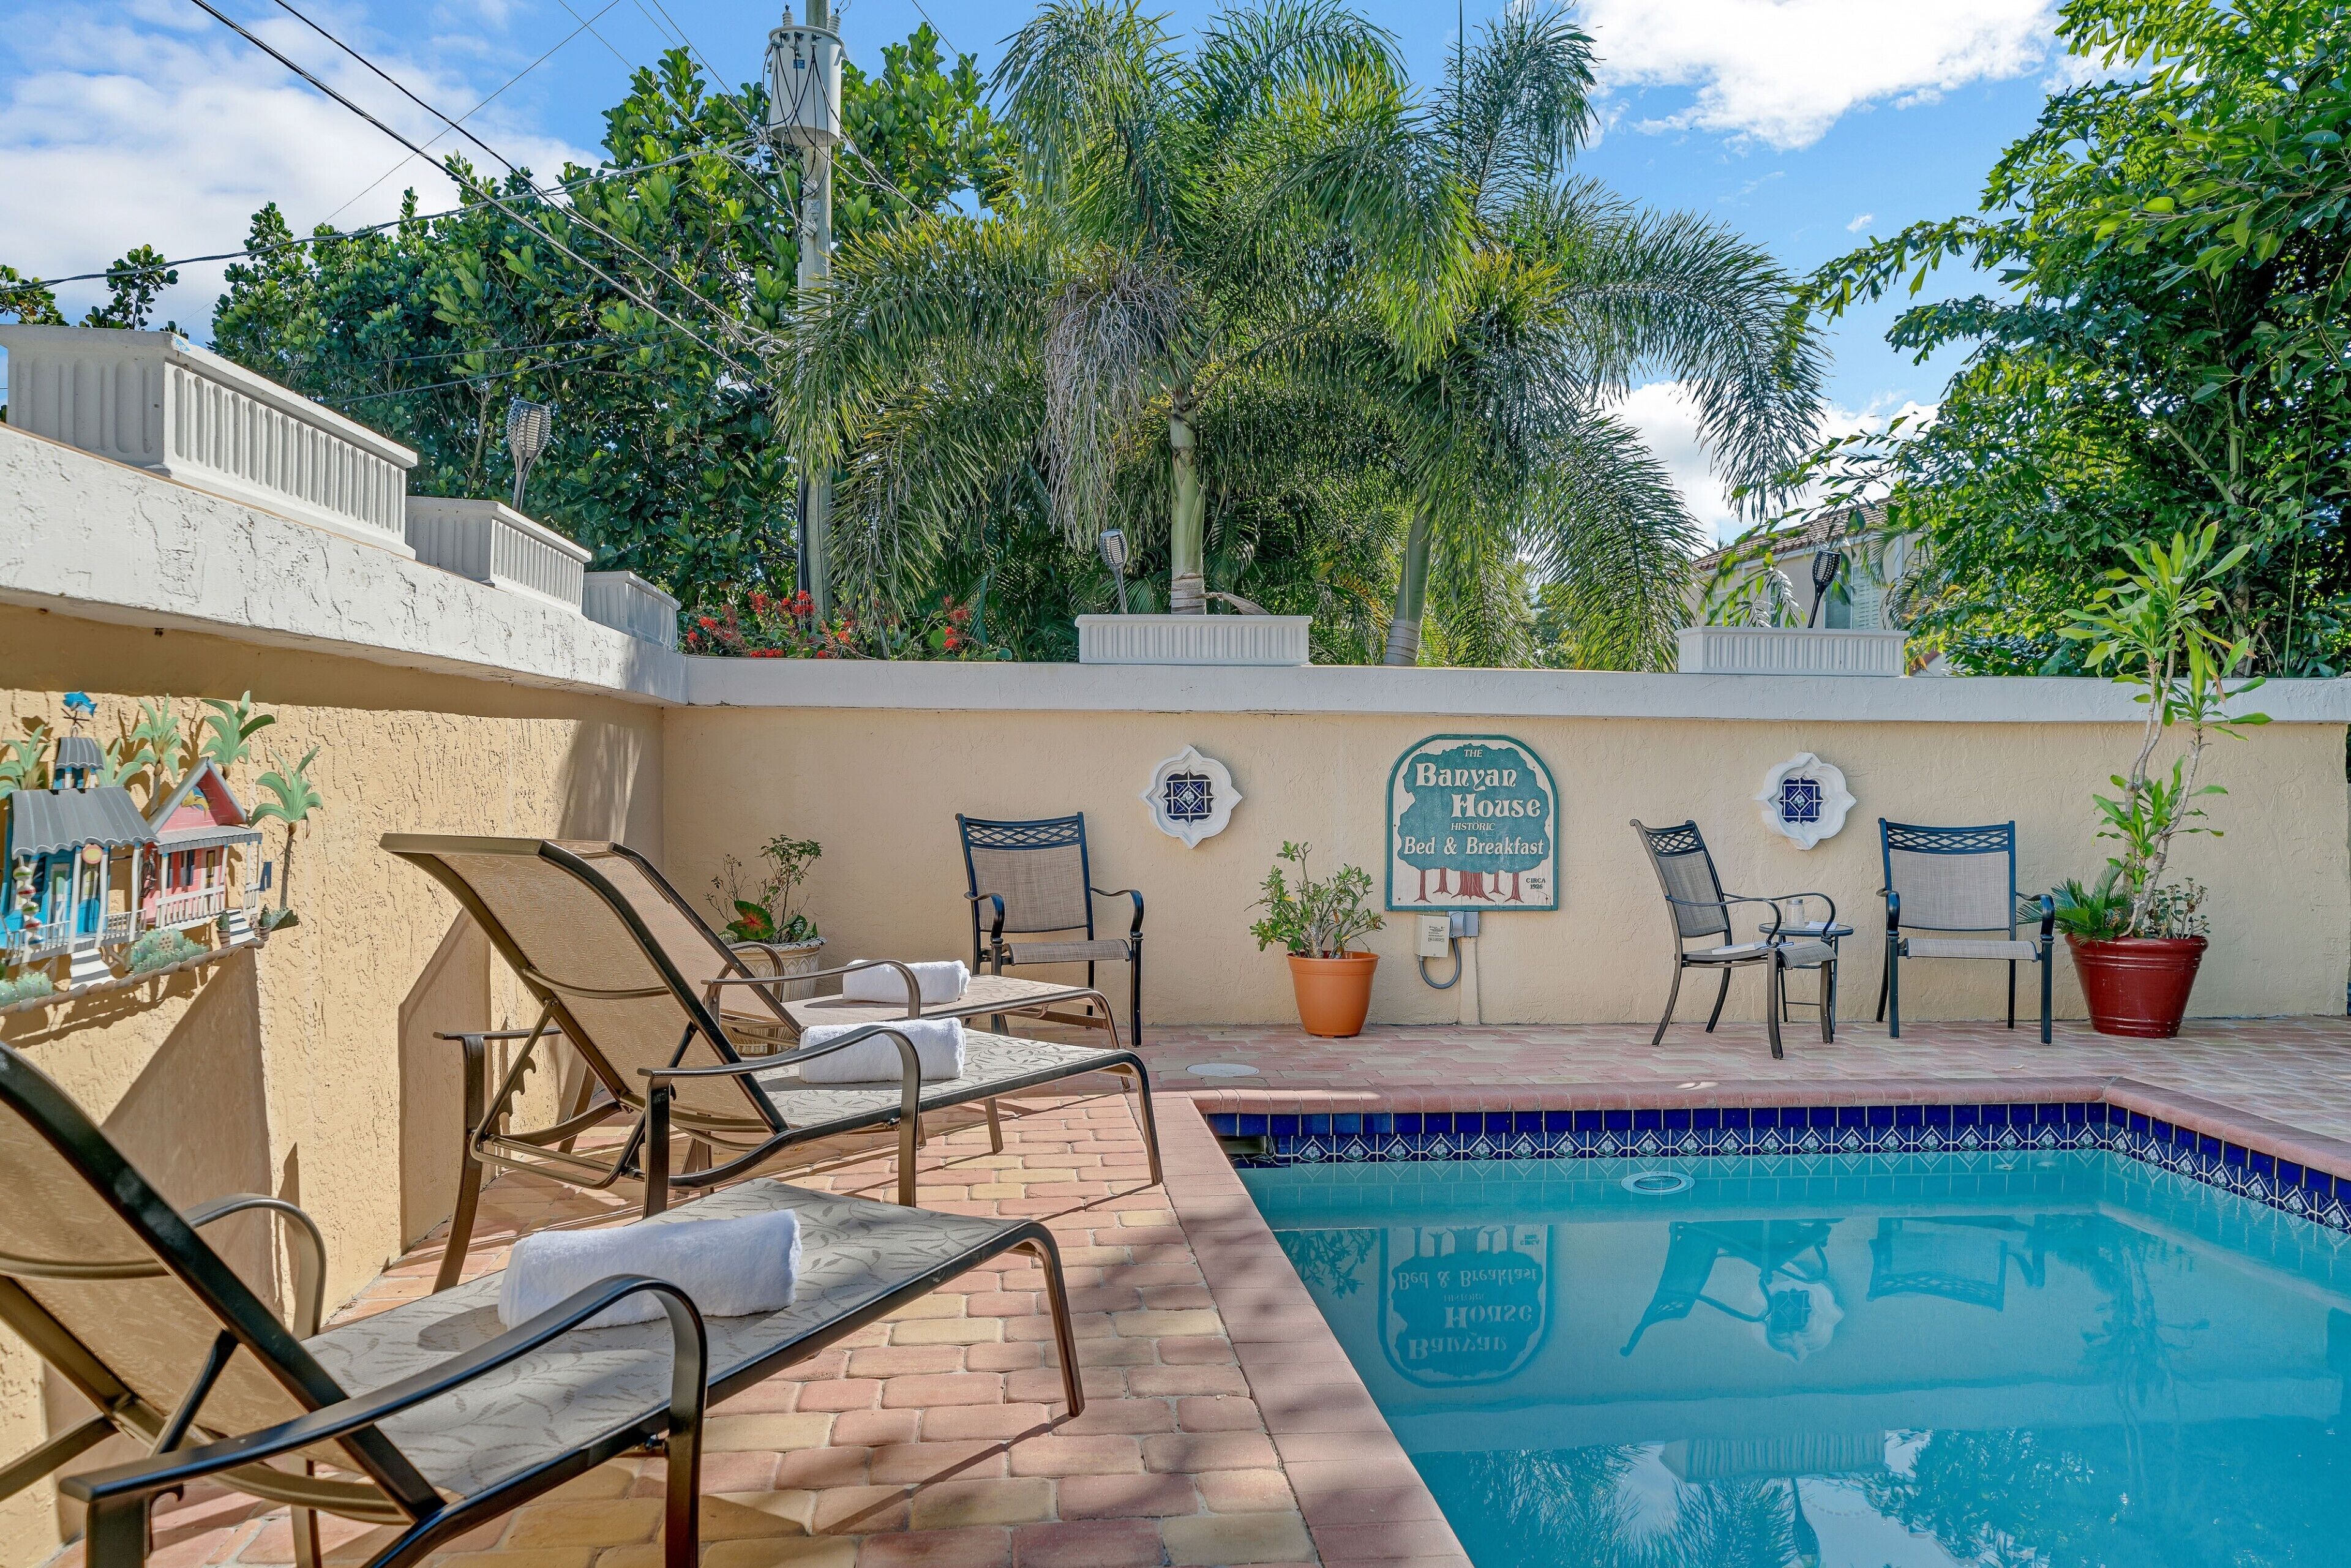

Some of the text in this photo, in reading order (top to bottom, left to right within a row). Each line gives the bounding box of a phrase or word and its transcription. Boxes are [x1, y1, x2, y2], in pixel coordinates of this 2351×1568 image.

[1464, 749, 1483, 757] THE
[1415, 762, 1517, 791] Banyan
[1450, 793, 1541, 818] House
[1451, 822, 1496, 831] HISTORIC
[1403, 836, 1544, 855] Bed & Breakfast
